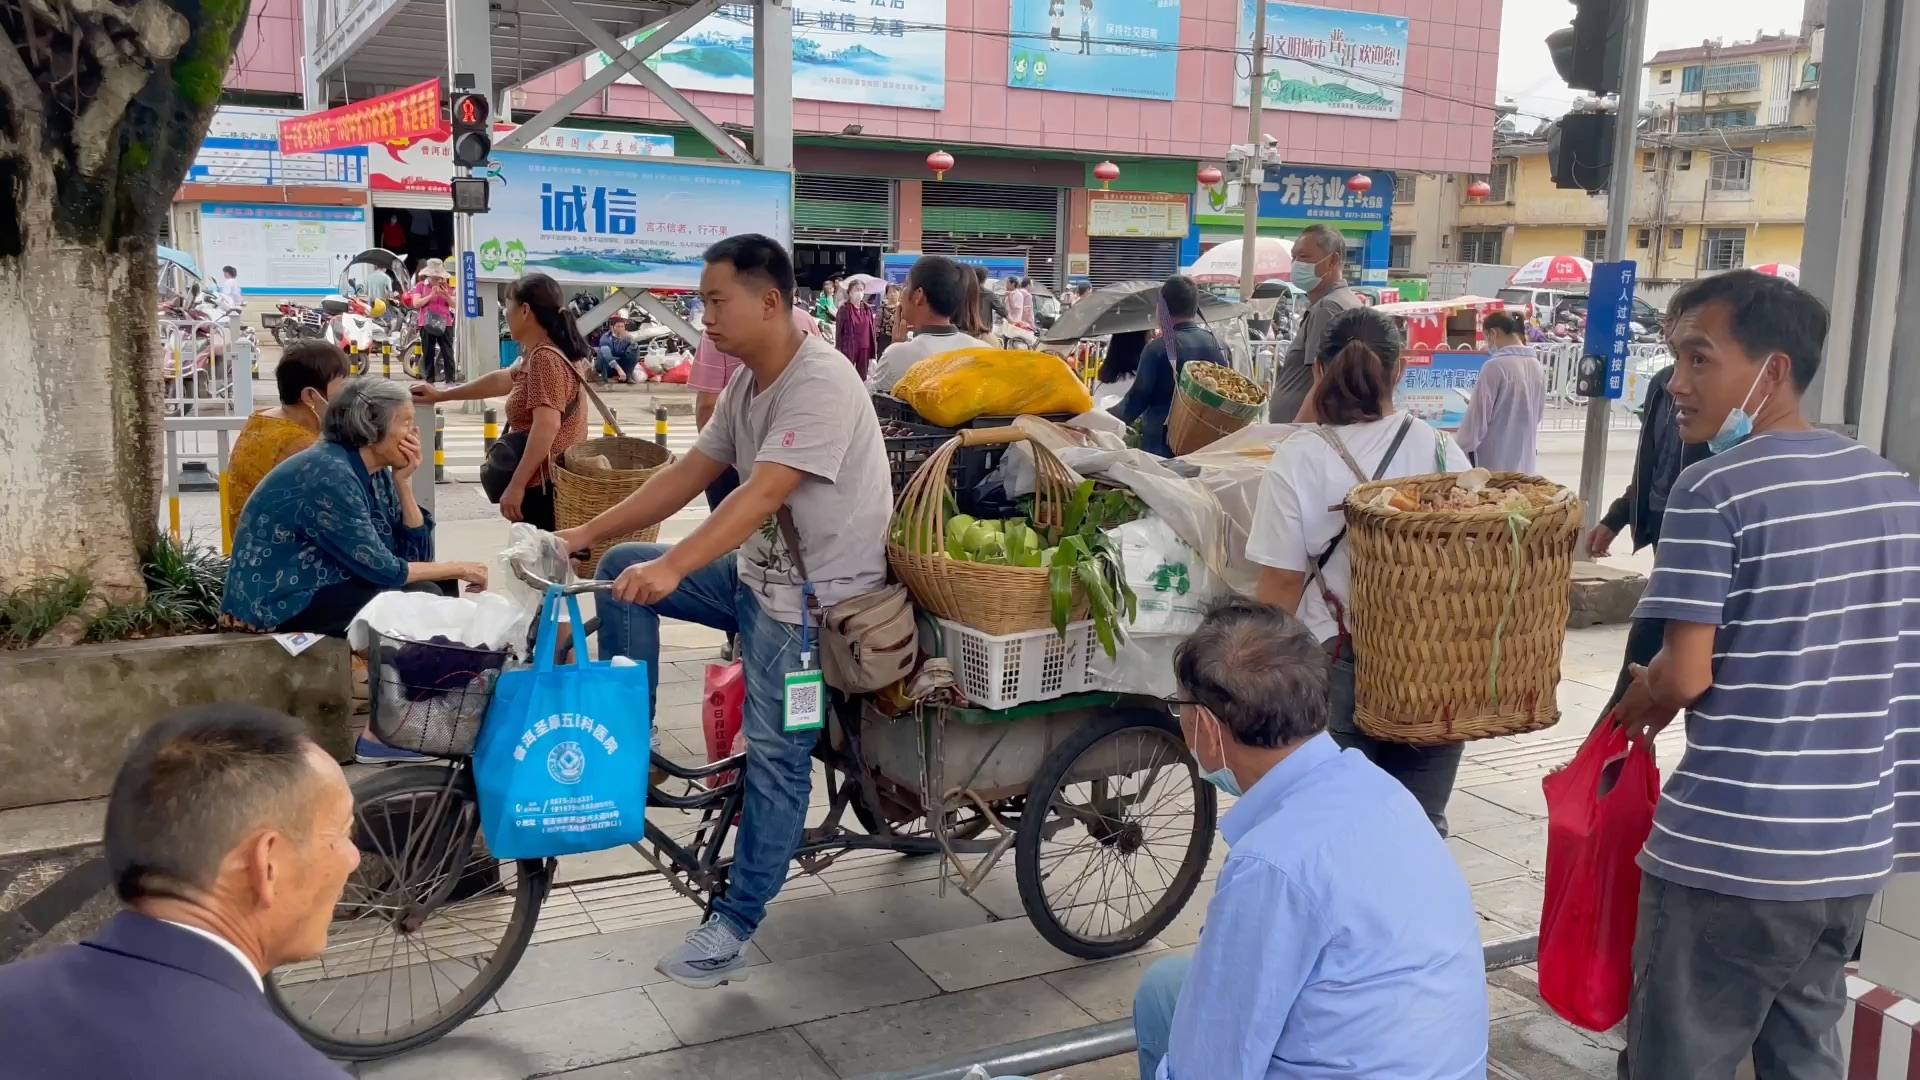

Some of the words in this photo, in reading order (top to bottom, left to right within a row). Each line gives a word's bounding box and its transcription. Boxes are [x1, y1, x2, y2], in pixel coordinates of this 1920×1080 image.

[819, 11, 855, 32] 诚信
[870, 16, 904, 38] 友善
[1249, 31, 1326, 59] 国文明城市
[421, 145, 453, 157] 普洱市
[540, 134, 653, 153] 巩固国家卫生城市
[1260, 173, 1345, 208] 一方药业
[540, 182, 637, 235] 诚信
[645, 222, 728, 237] 言不信者，行不果
[1609, 269, 1632, 389] 行人过街请按钮
